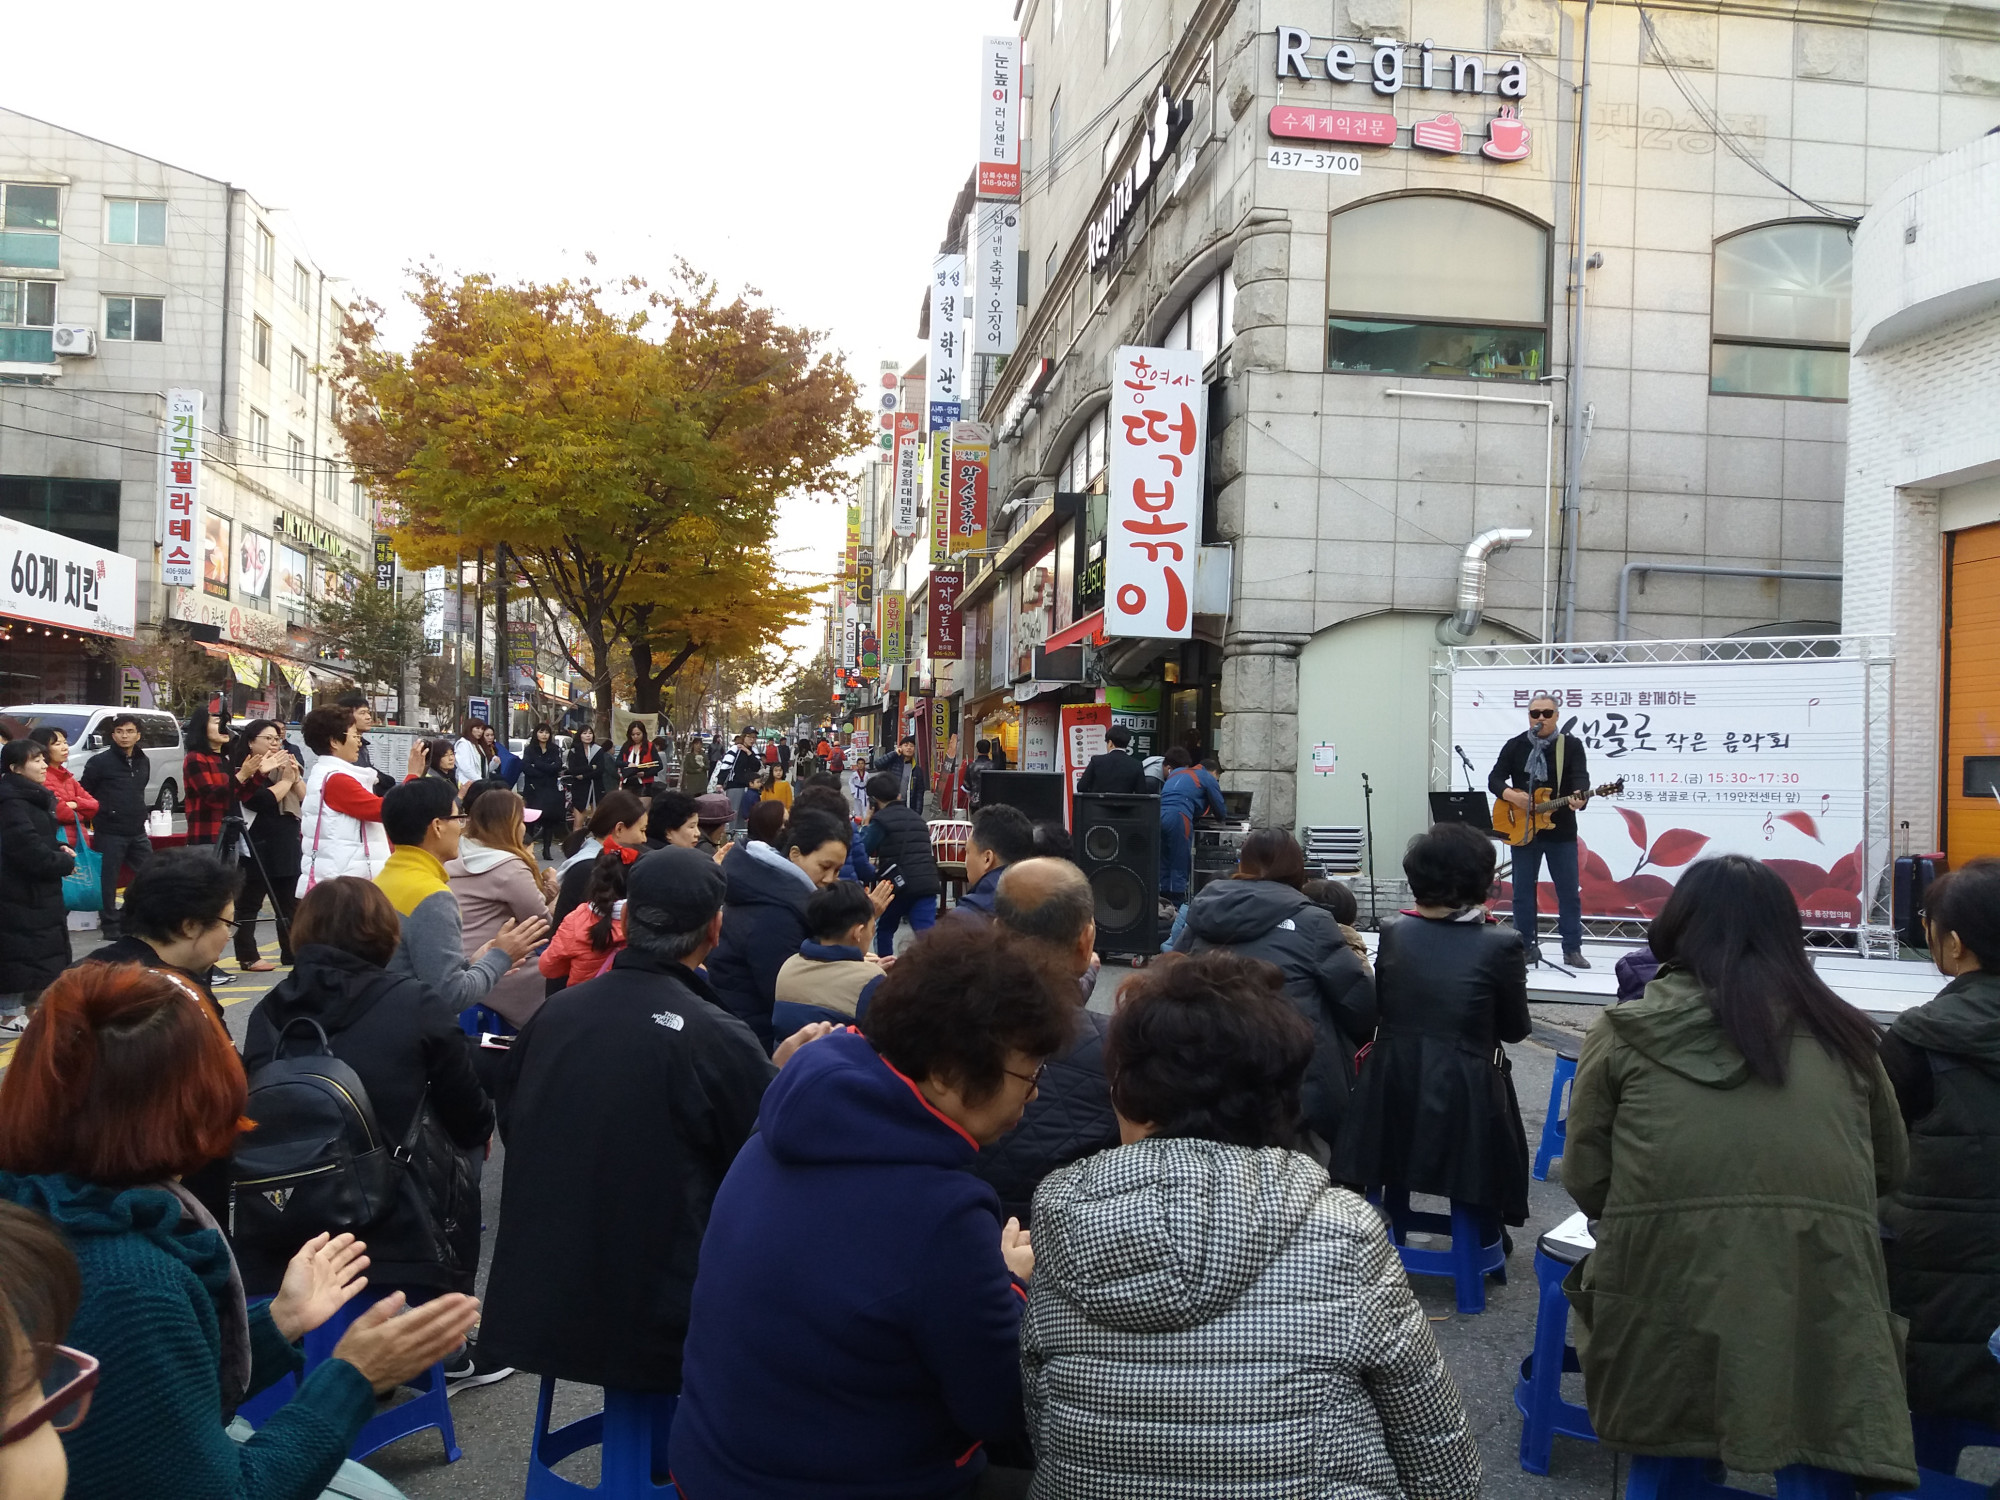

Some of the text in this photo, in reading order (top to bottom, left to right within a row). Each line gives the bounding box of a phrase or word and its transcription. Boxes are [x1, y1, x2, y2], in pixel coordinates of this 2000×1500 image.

[1276, 26, 1528, 98] Regina
[994, 107, 1006, 158] 러닝센터
[1282, 112, 1386, 137] 수제케익전문
[1270, 151, 1360, 171] 437-3700
[1088, 166, 1133, 274] Regina
[993, 236, 1003, 257] 내린
[936, 295, 958, 394] 철학관
[1124, 355, 1196, 404] 홍여사
[166, 414, 195, 565] 기구필라테스
[1116, 402, 1198, 632] 떡볶이
[11, 549, 98, 612] 60계 치킨
[165, 567, 192, 575] 406-9884
[857, 566, 872, 602] PC
[938, 586, 955, 642] 자연드림
[888, 632, 899, 655] 서비스
[1512, 688, 1697, 708] 본3동 주민과 함께하는
[935, 703, 944, 737] SBS
[1665, 731, 1708, 753] 작은
[1722, 731, 1790, 753] 음악회
[1708, 772, 1800, 784] 15:30~17:30
[1657, 791, 1689, 801] 샘골로
[1715, 791, 1781, 803] 119안전센터
